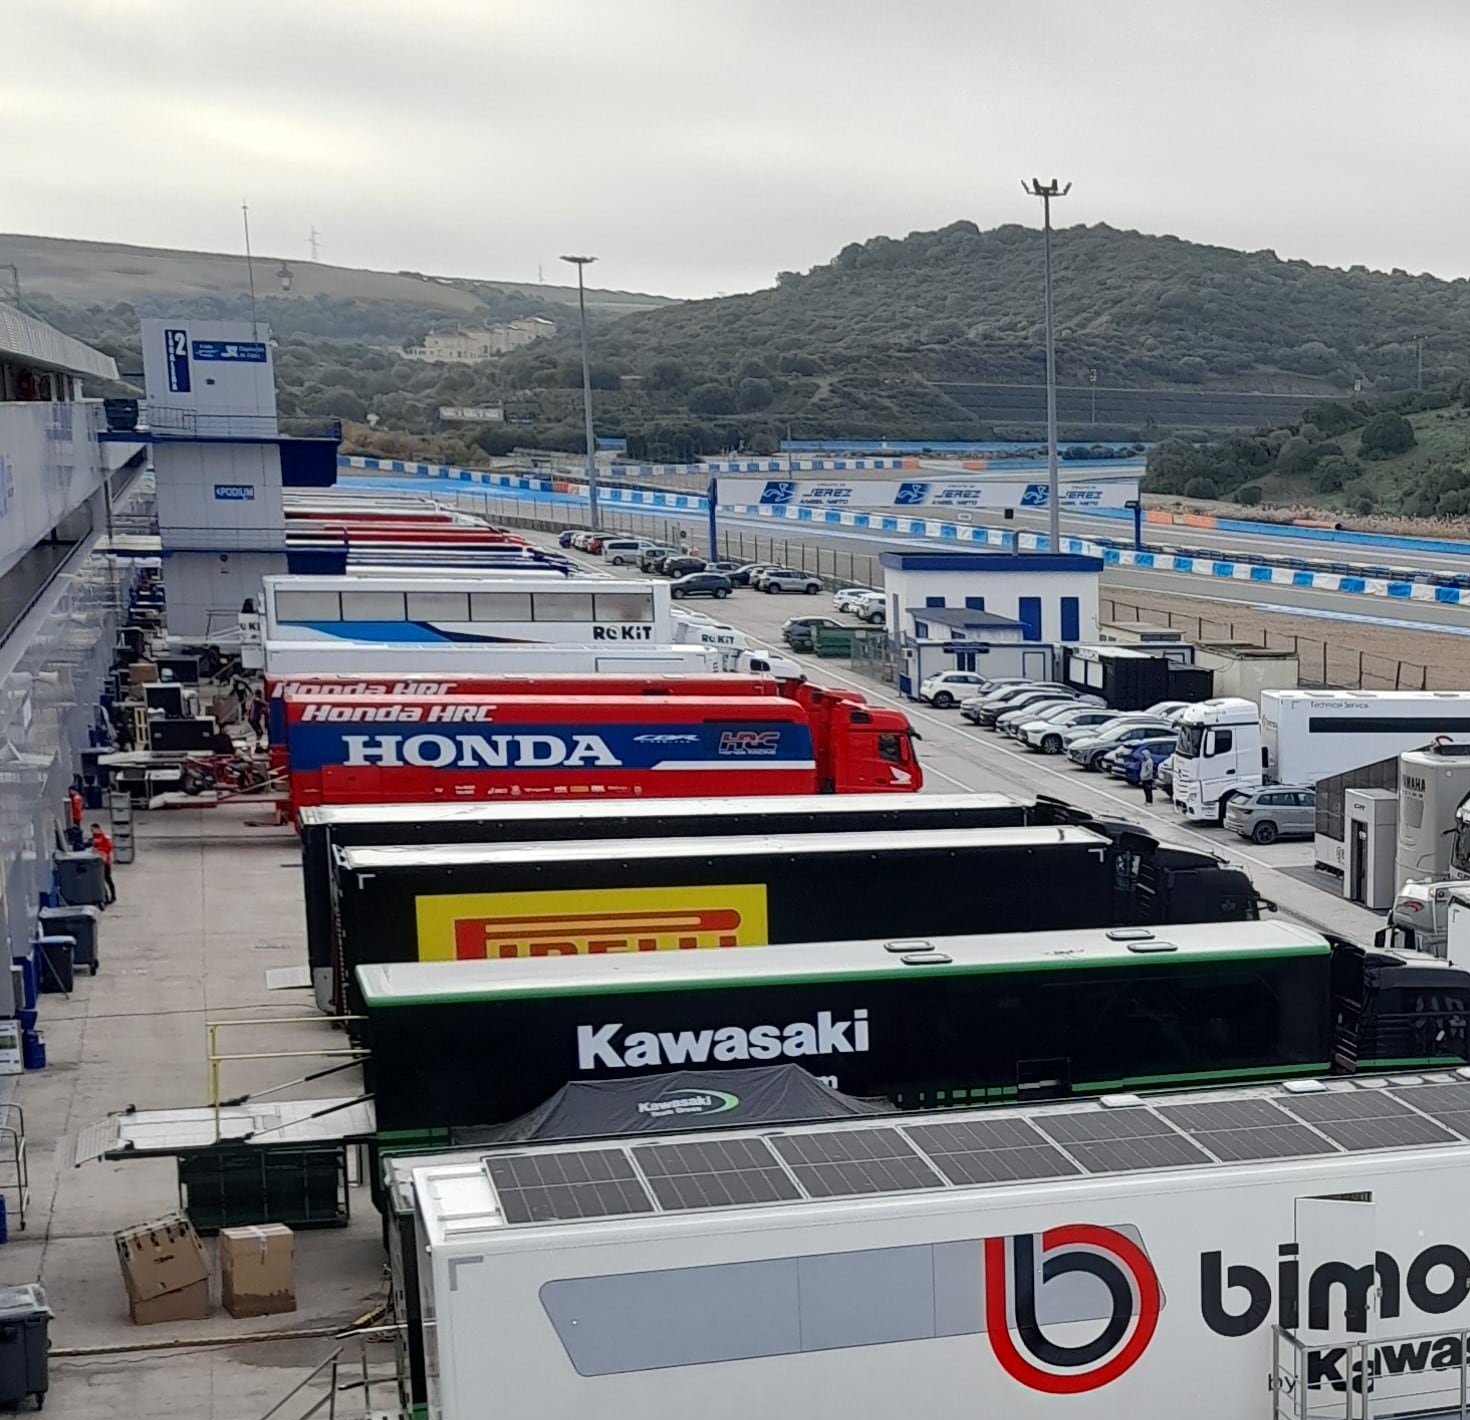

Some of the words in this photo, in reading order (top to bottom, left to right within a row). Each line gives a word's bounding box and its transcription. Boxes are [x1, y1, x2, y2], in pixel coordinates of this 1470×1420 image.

[174, 332, 187, 355] 2
[220, 486, 253, 497] PODIUM
[301, 704, 423, 723] Honda
[426, 704, 498, 722] HRC
[341, 733, 623, 768] HONDA
[576, 1007, 870, 1071] Kawasaki
[637, 1095, 712, 1113] Kawasaki
[1267, 1372, 1298, 1394] by
